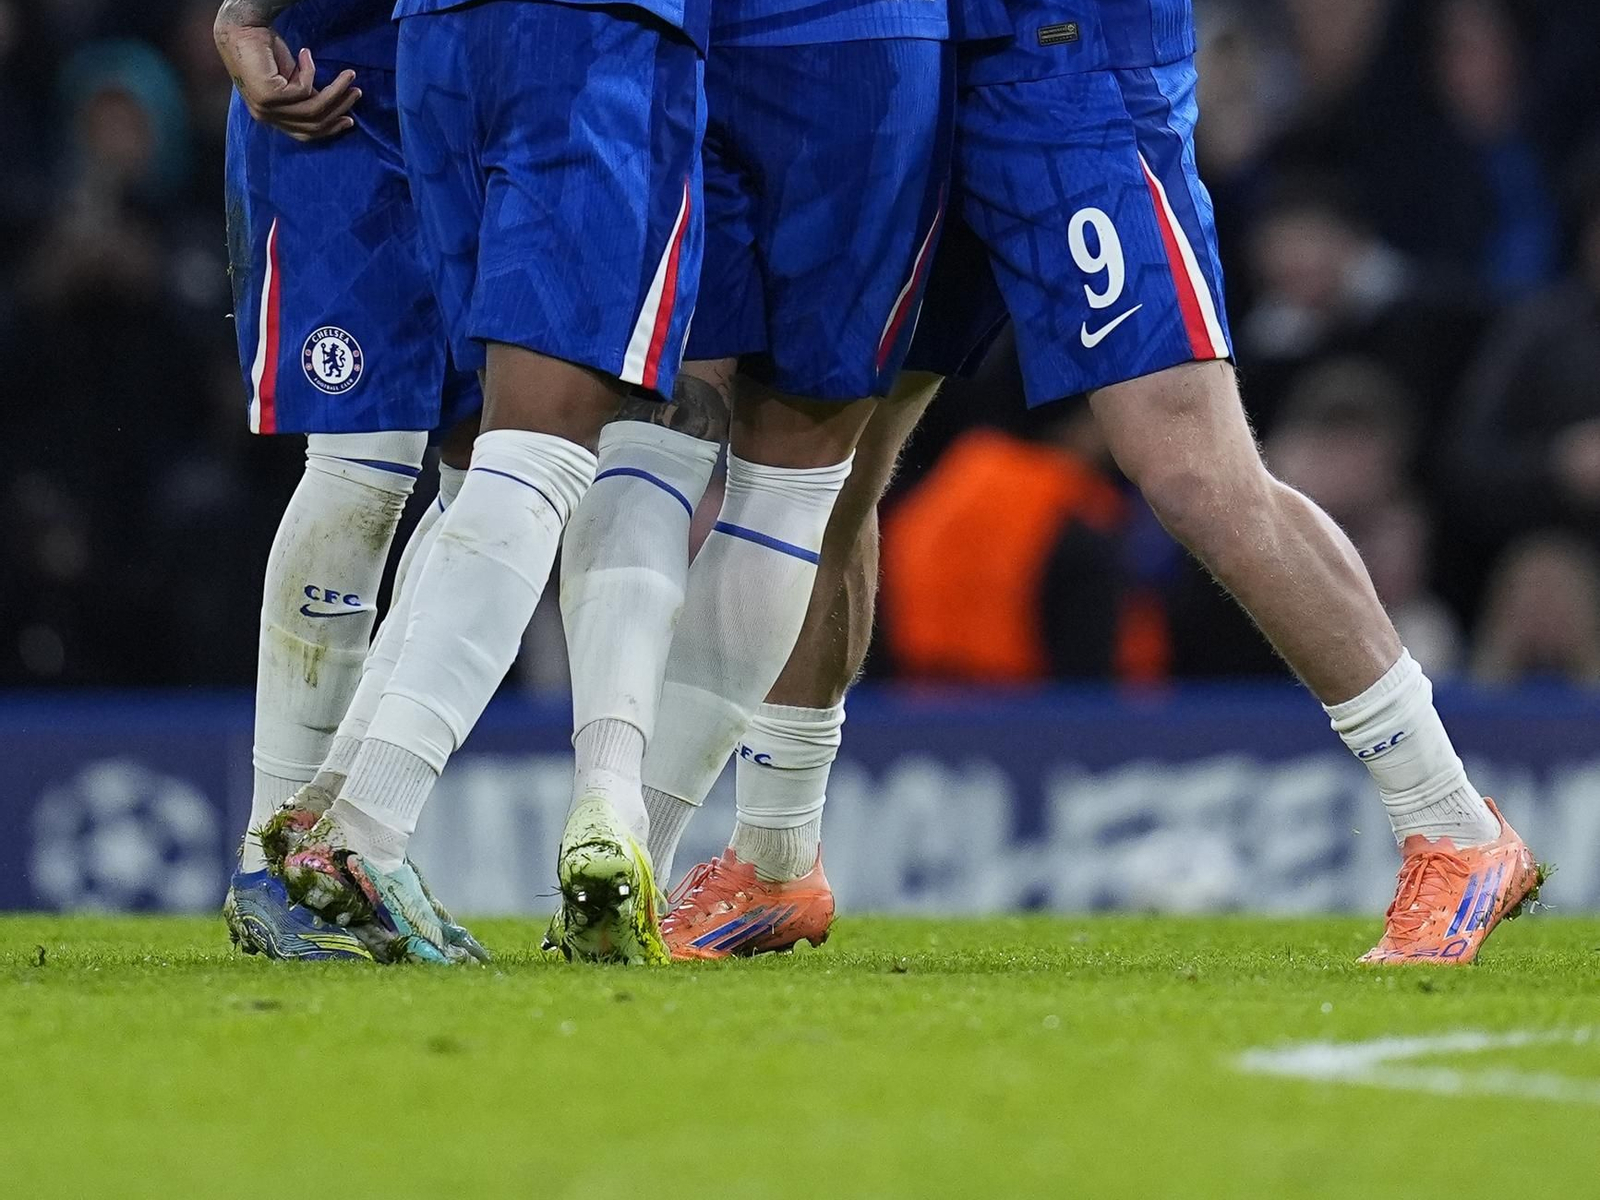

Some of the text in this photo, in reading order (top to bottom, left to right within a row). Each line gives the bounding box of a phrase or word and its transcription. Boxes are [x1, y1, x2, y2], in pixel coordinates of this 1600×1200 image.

[1067, 207, 1125, 309] 9
[311, 329, 350, 344] CHELSEA
[304, 584, 361, 606] CFC
[734, 742, 772, 767] FC
